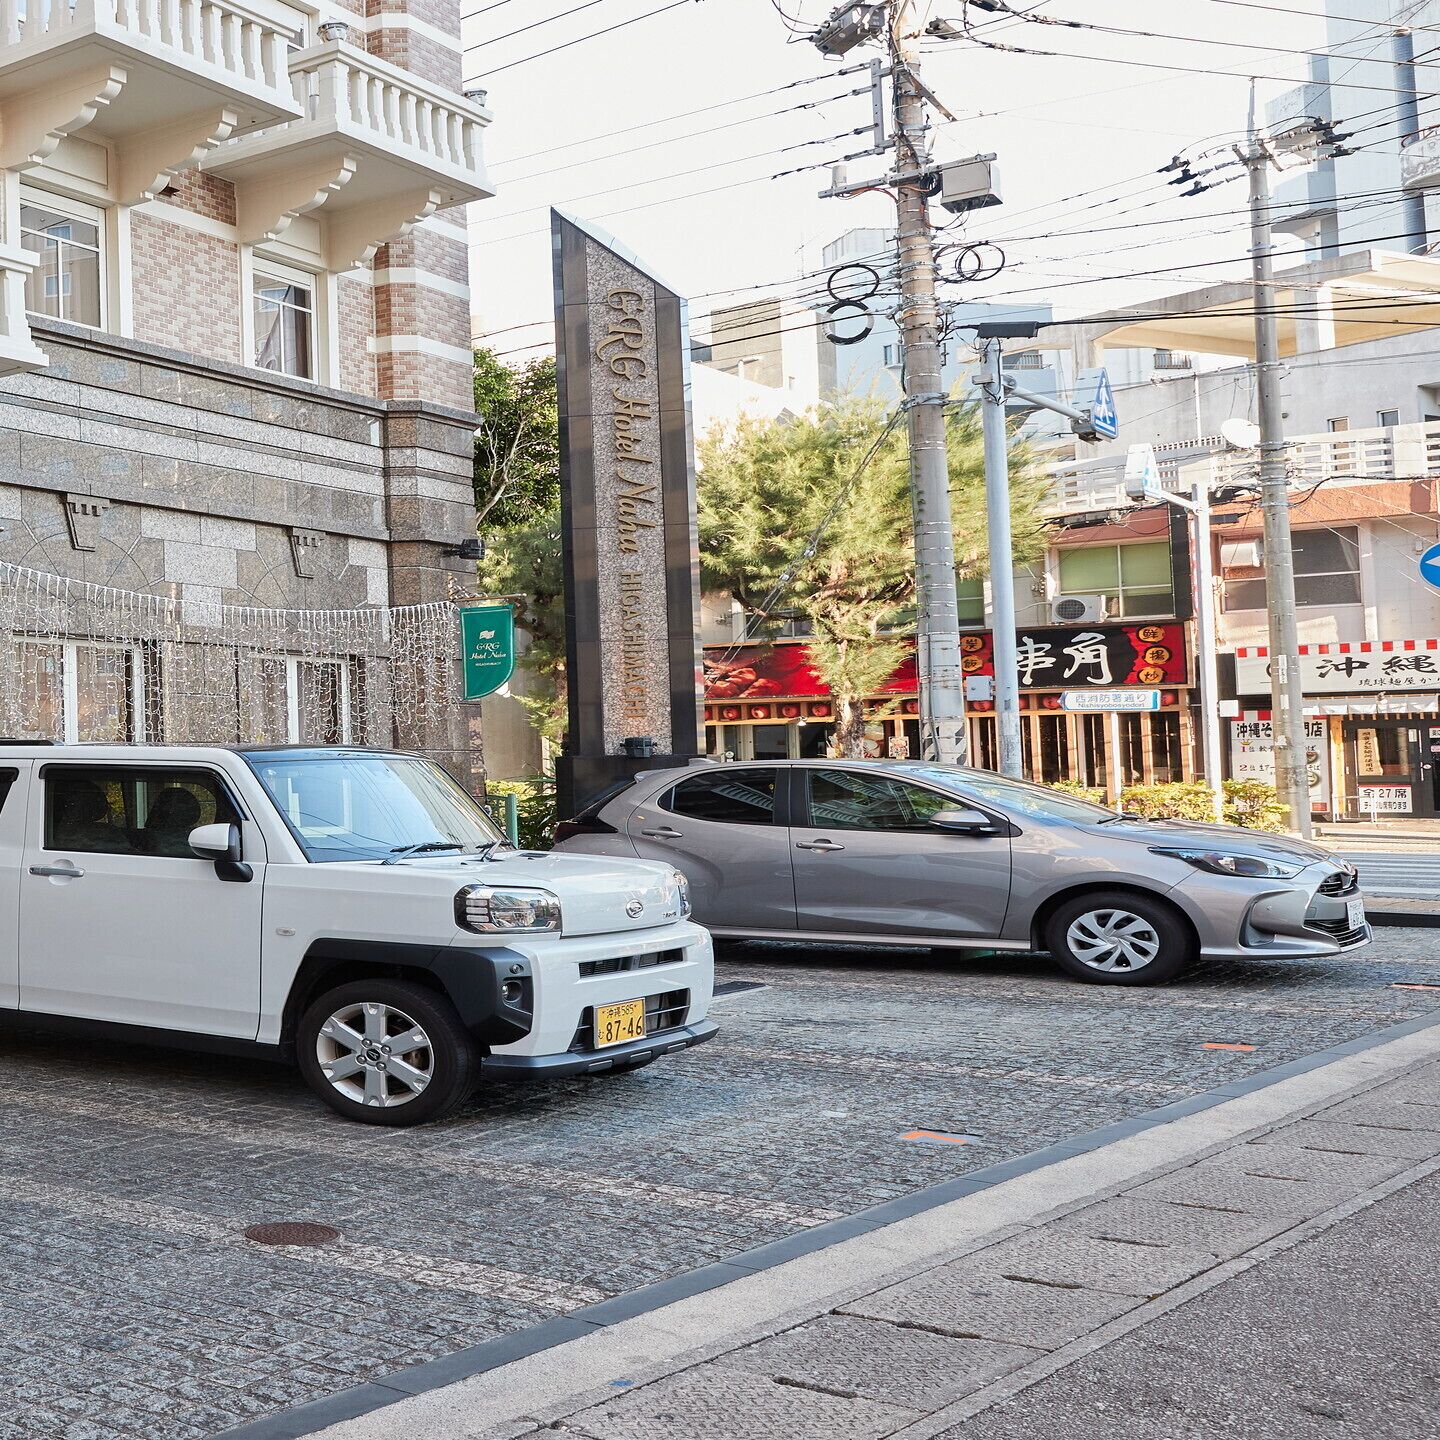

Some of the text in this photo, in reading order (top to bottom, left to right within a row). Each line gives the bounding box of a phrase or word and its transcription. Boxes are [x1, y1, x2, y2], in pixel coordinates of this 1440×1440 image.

[596, 287, 658, 720] GRG Hotel Naha HIGASHIMACHI
[476, 641, 500, 652] GRG
[1315, 655, 1439, 679] 沖縄
[1144, 670, 1159, 683] 炒
[1075, 693, 1147, 703] 西消防署通り
[606, 1015, 643, 1043] 87-46
